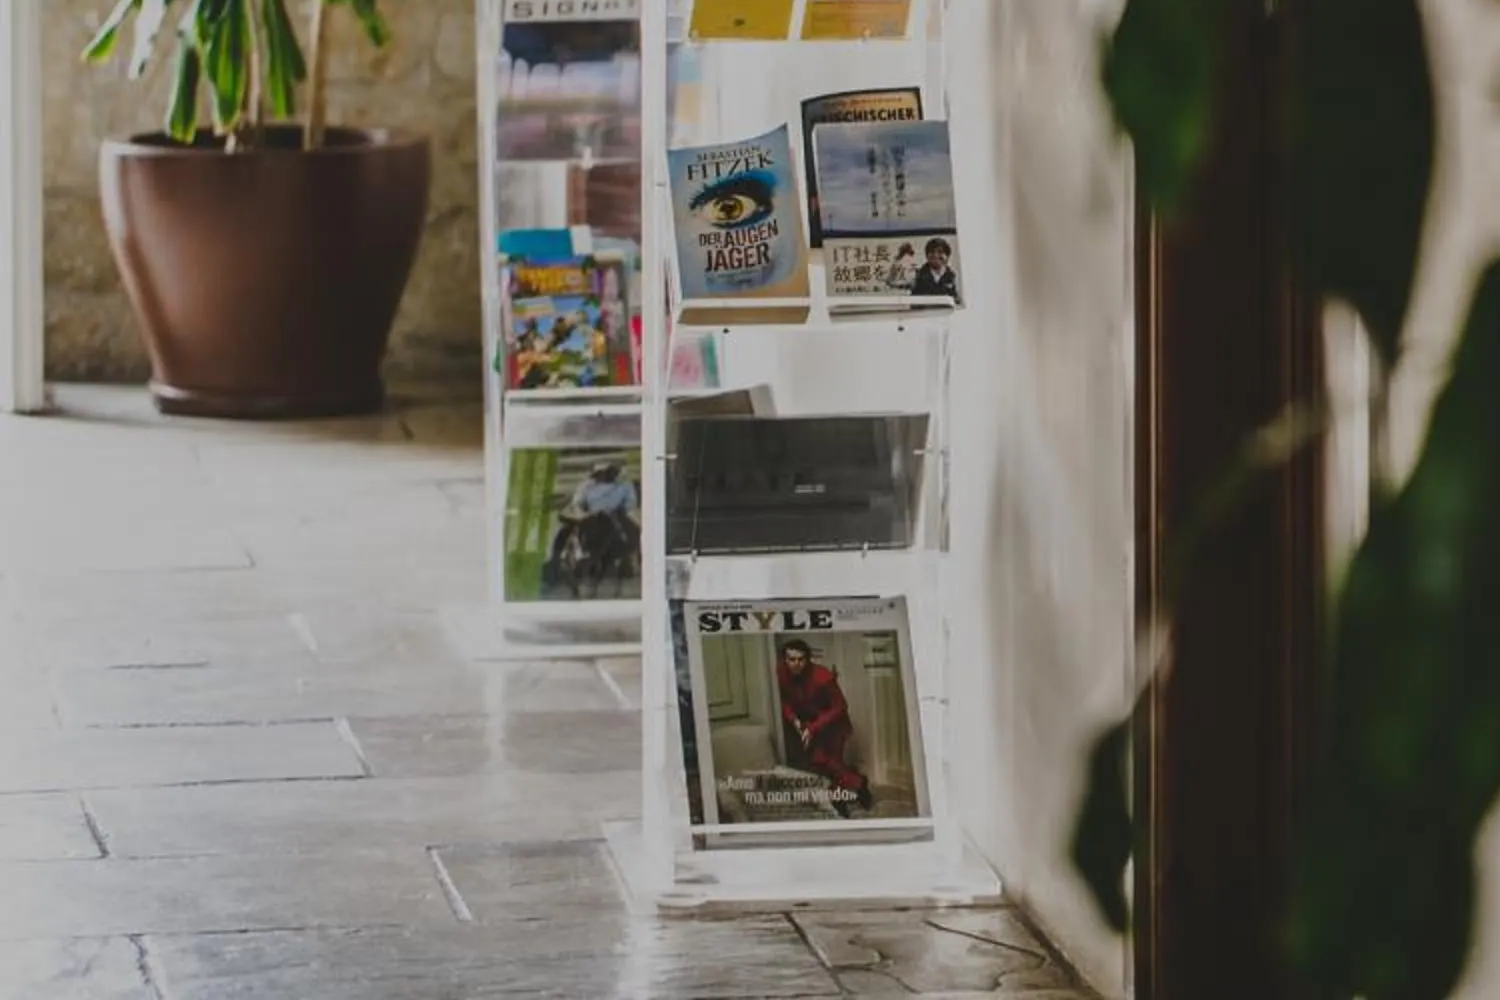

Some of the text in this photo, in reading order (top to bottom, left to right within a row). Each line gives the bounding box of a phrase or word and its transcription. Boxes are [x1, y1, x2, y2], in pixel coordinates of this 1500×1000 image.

[687, 148, 775, 181] FITZEK
[698, 218, 779, 249] DER AUGEN
[698, 609, 833, 633] STYLE
